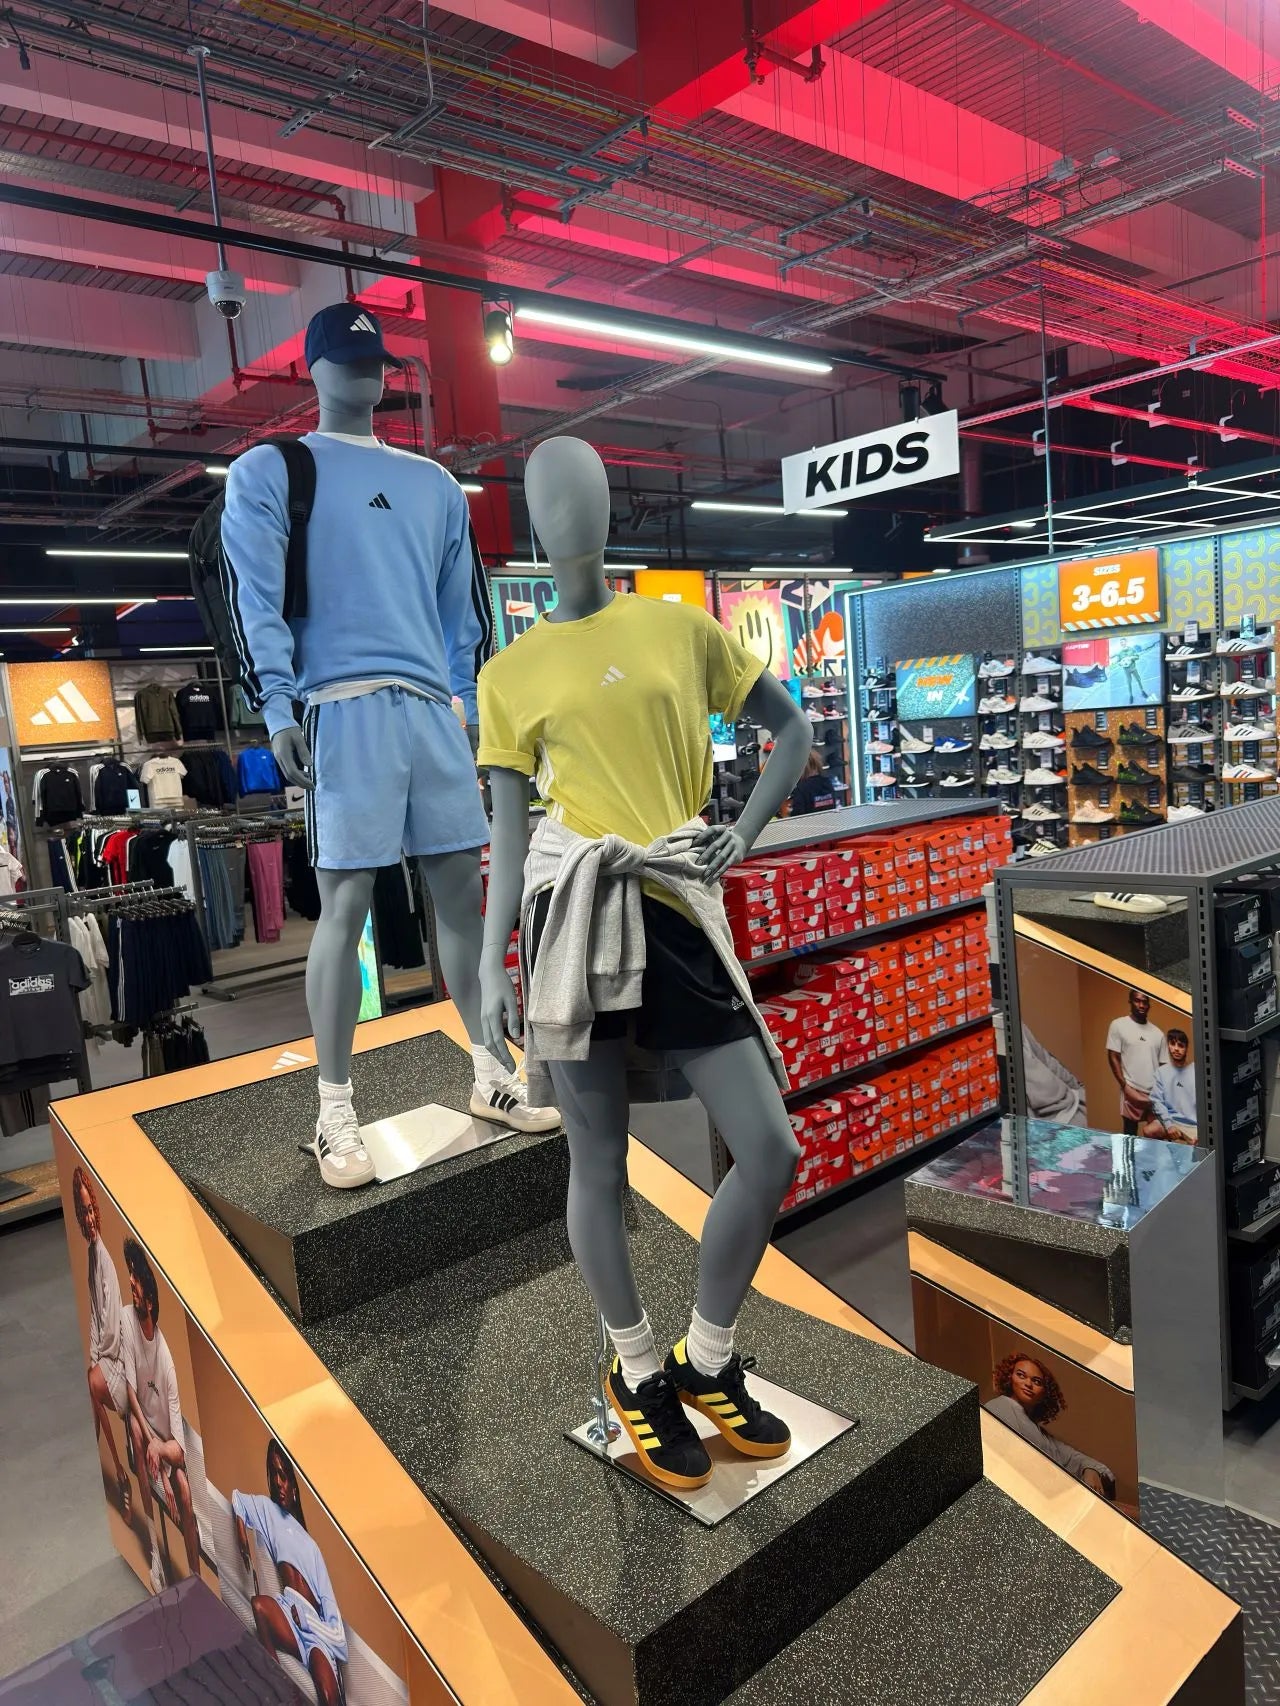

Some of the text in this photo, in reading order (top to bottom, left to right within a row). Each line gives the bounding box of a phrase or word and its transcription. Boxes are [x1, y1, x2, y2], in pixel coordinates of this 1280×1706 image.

[805, 431, 930, 498] KIDS
[1071, 576, 1146, 612] 3-6.5
[11, 976, 53, 990] adidas
